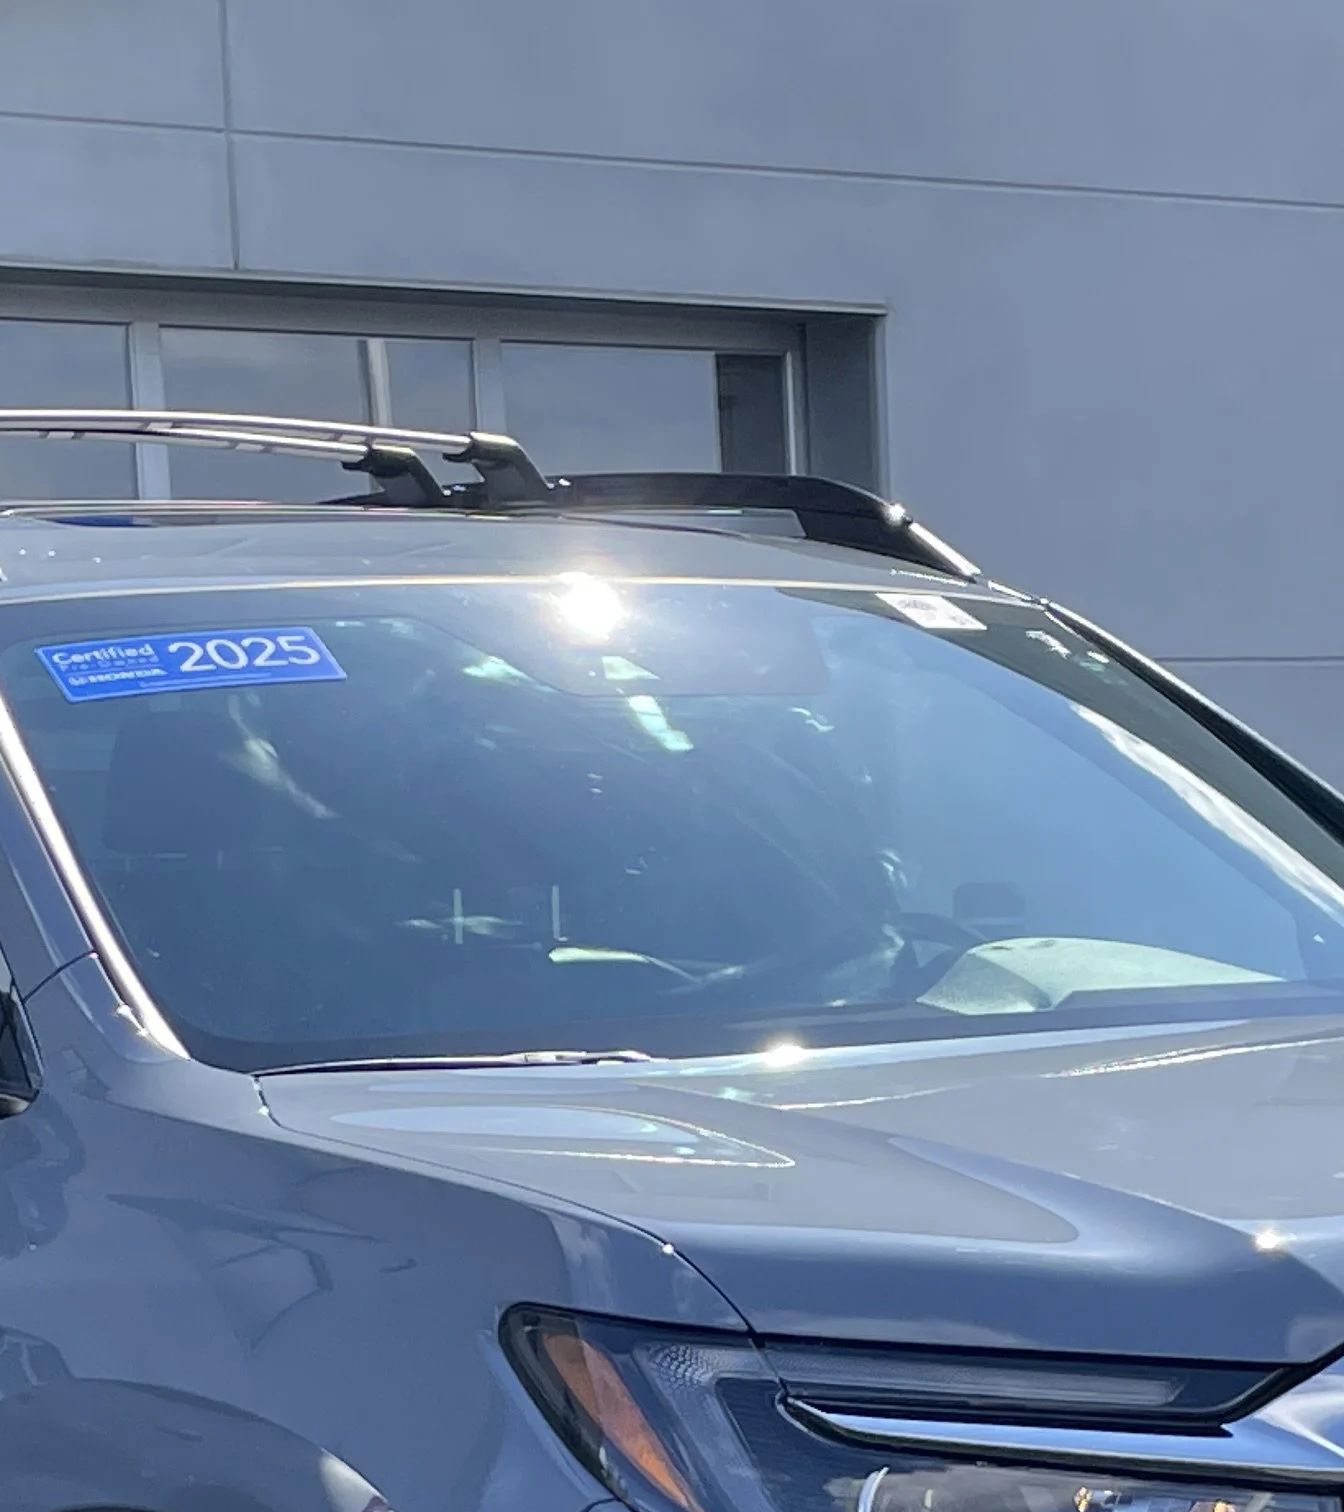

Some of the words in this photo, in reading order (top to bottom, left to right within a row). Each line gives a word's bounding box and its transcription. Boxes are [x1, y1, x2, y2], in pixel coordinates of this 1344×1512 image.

[52, 643, 155, 664] Certified
[167, 635, 321, 673] 2025
[87, 668, 168, 682] HONDA
